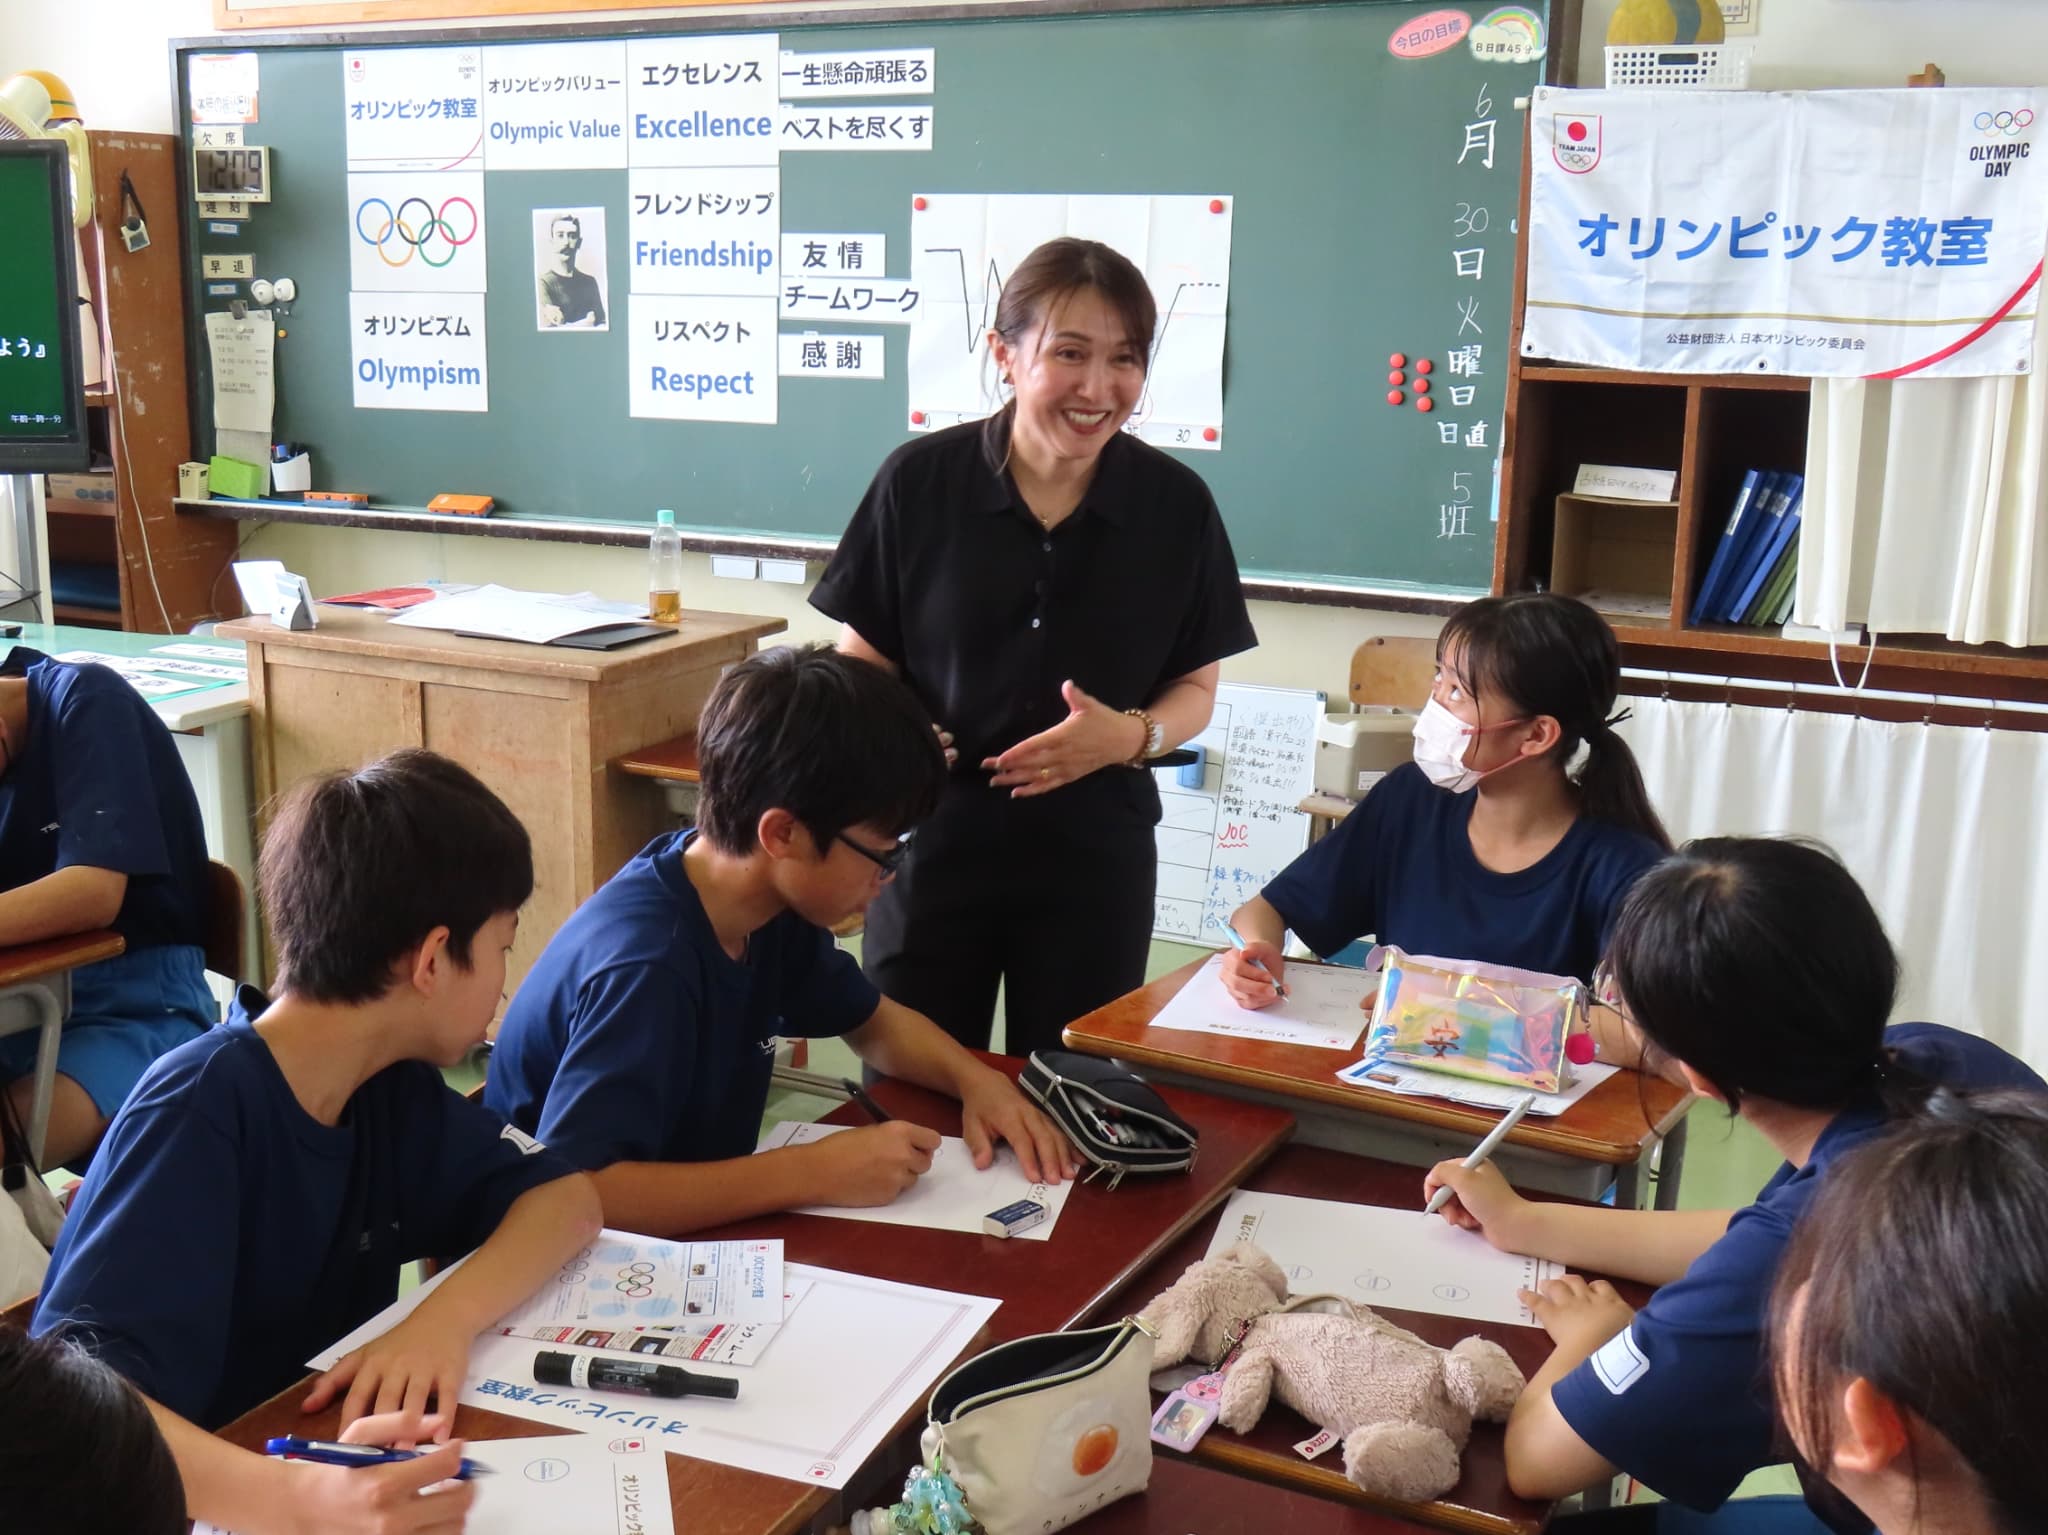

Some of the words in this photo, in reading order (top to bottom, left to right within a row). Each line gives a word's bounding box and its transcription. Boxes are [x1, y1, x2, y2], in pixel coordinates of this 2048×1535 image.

[1395, 19, 1462, 50] 今日の目標
[488, 75, 621, 94] オリンピックバリュー
[642, 61, 762, 86] エクセレンス
[782, 59, 928, 86] 一生懸命頑張る
[351, 97, 477, 120] オリンピック教室
[490, 121, 563, 144] Olympic
[569, 119, 621, 139] Value
[635, 110, 772, 139] Excellence
[782, 115, 930, 140] ベストを尽くす
[203, 131, 236, 146] 欠席
[1969, 142, 2031, 161] OLYMPIC
[1984, 161, 2012, 178] DAY
[634, 192, 775, 216] フレンドシップ
[1578, 212, 1993, 268] オリンピック教室
[211, 260, 245, 274] 早退
[636, 240, 773, 275] Friendship
[802, 240, 863, 270] 友情
[785, 285, 920, 313] チームワーク
[364, 315, 471, 337] オリンピズム
[654, 320, 751, 344] リスペクト
[1666, 332, 1737, 346] 公益財団法人
[1739, 333, 1867, 351] 日本オリンピック委員会
[801, 340, 862, 369] 感謝
[358, 358, 480, 391] Olympism
[651, 366, 754, 401] Respect
[1175, 428, 1191, 443] 30
[1437, 420, 1489, 448] 日直
[1217, 822, 1249, 841] JOC
[476, 1378, 689, 1434] オリンピック教室
[622, 1474, 645, 1535] オリンピック
